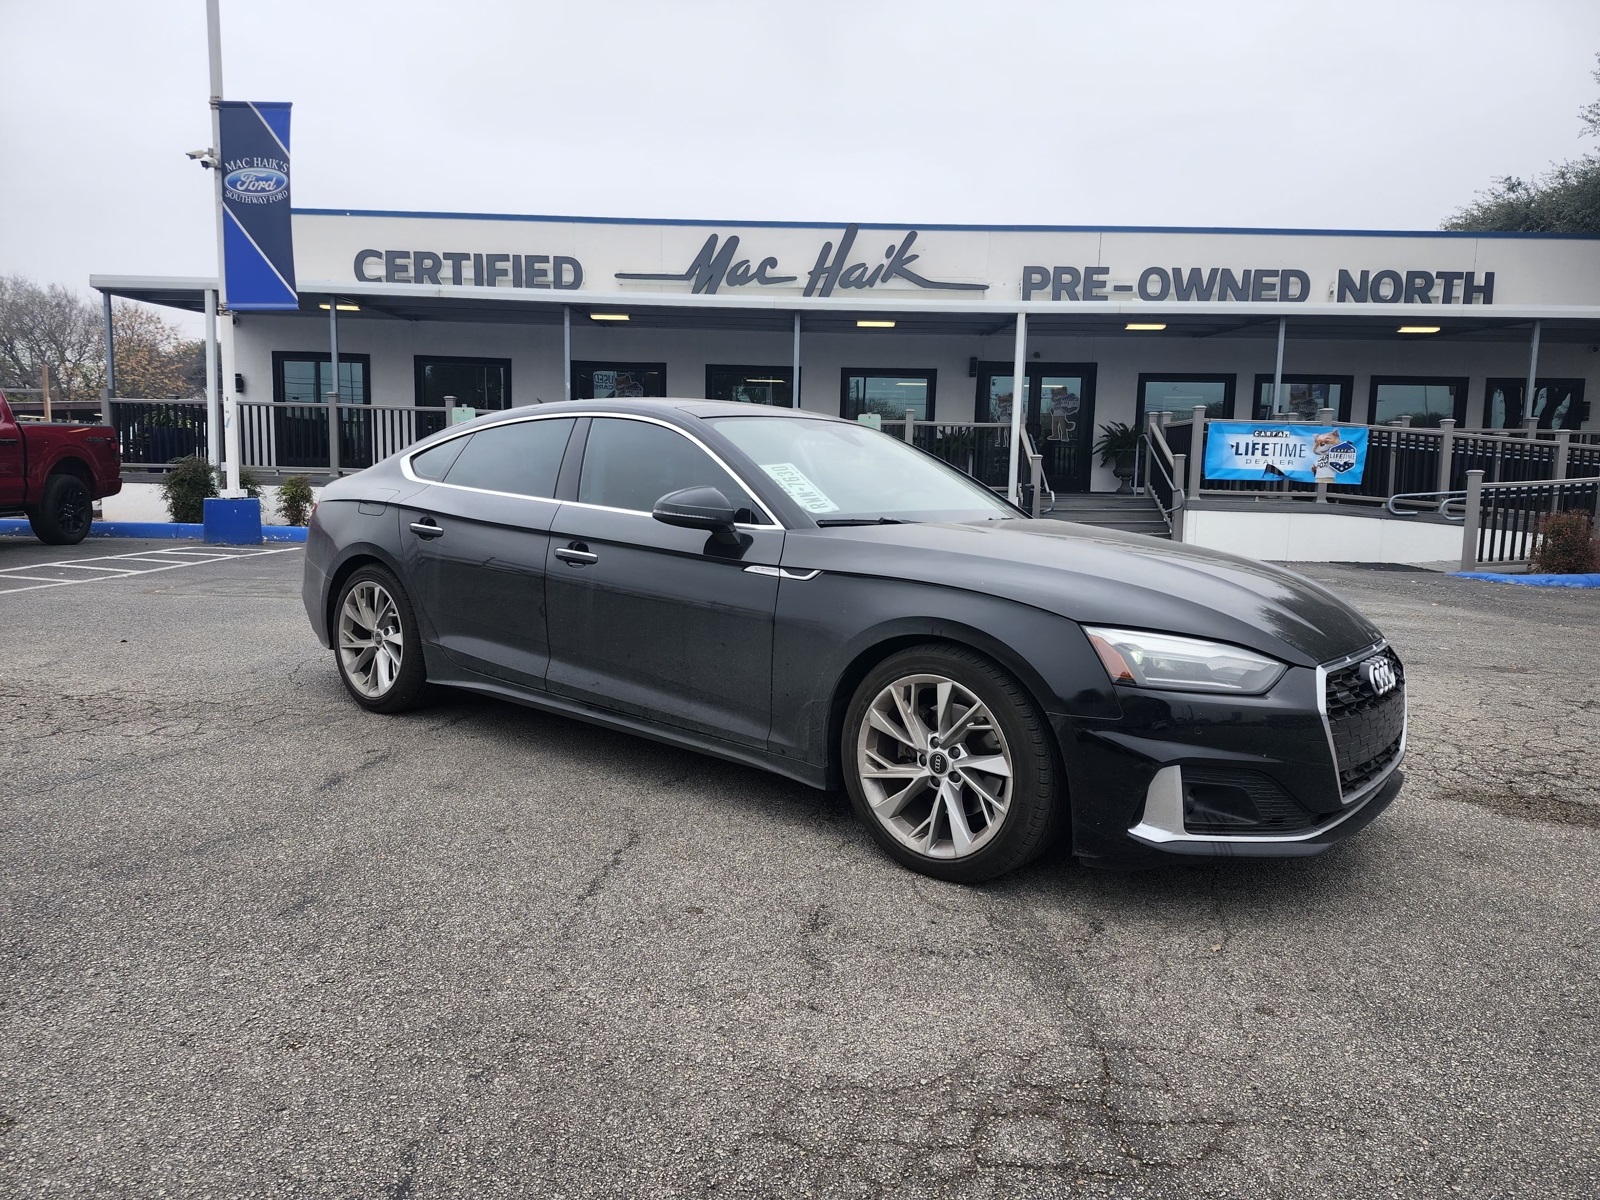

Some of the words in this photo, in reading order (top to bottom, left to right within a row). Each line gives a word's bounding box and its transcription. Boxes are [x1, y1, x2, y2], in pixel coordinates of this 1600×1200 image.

[225, 158, 250, 172] MAC
[253, 157, 289, 172] HAIK'S
[236, 172, 277, 191] Ford
[225, 190, 268, 204] SOUTHWAY
[269, 190, 288, 203] FORD
[614, 233, 798, 295] Mac
[803, 223, 990, 297] Haik
[353, 248, 584, 291] CERTIFIED
[1021, 266, 1311, 303] PRE-OWNED
[1336, 269, 1496, 305] NORTH
[1253, 430, 1291, 438] CARFAX
[1234, 441, 1308, 459] LIFETIME
